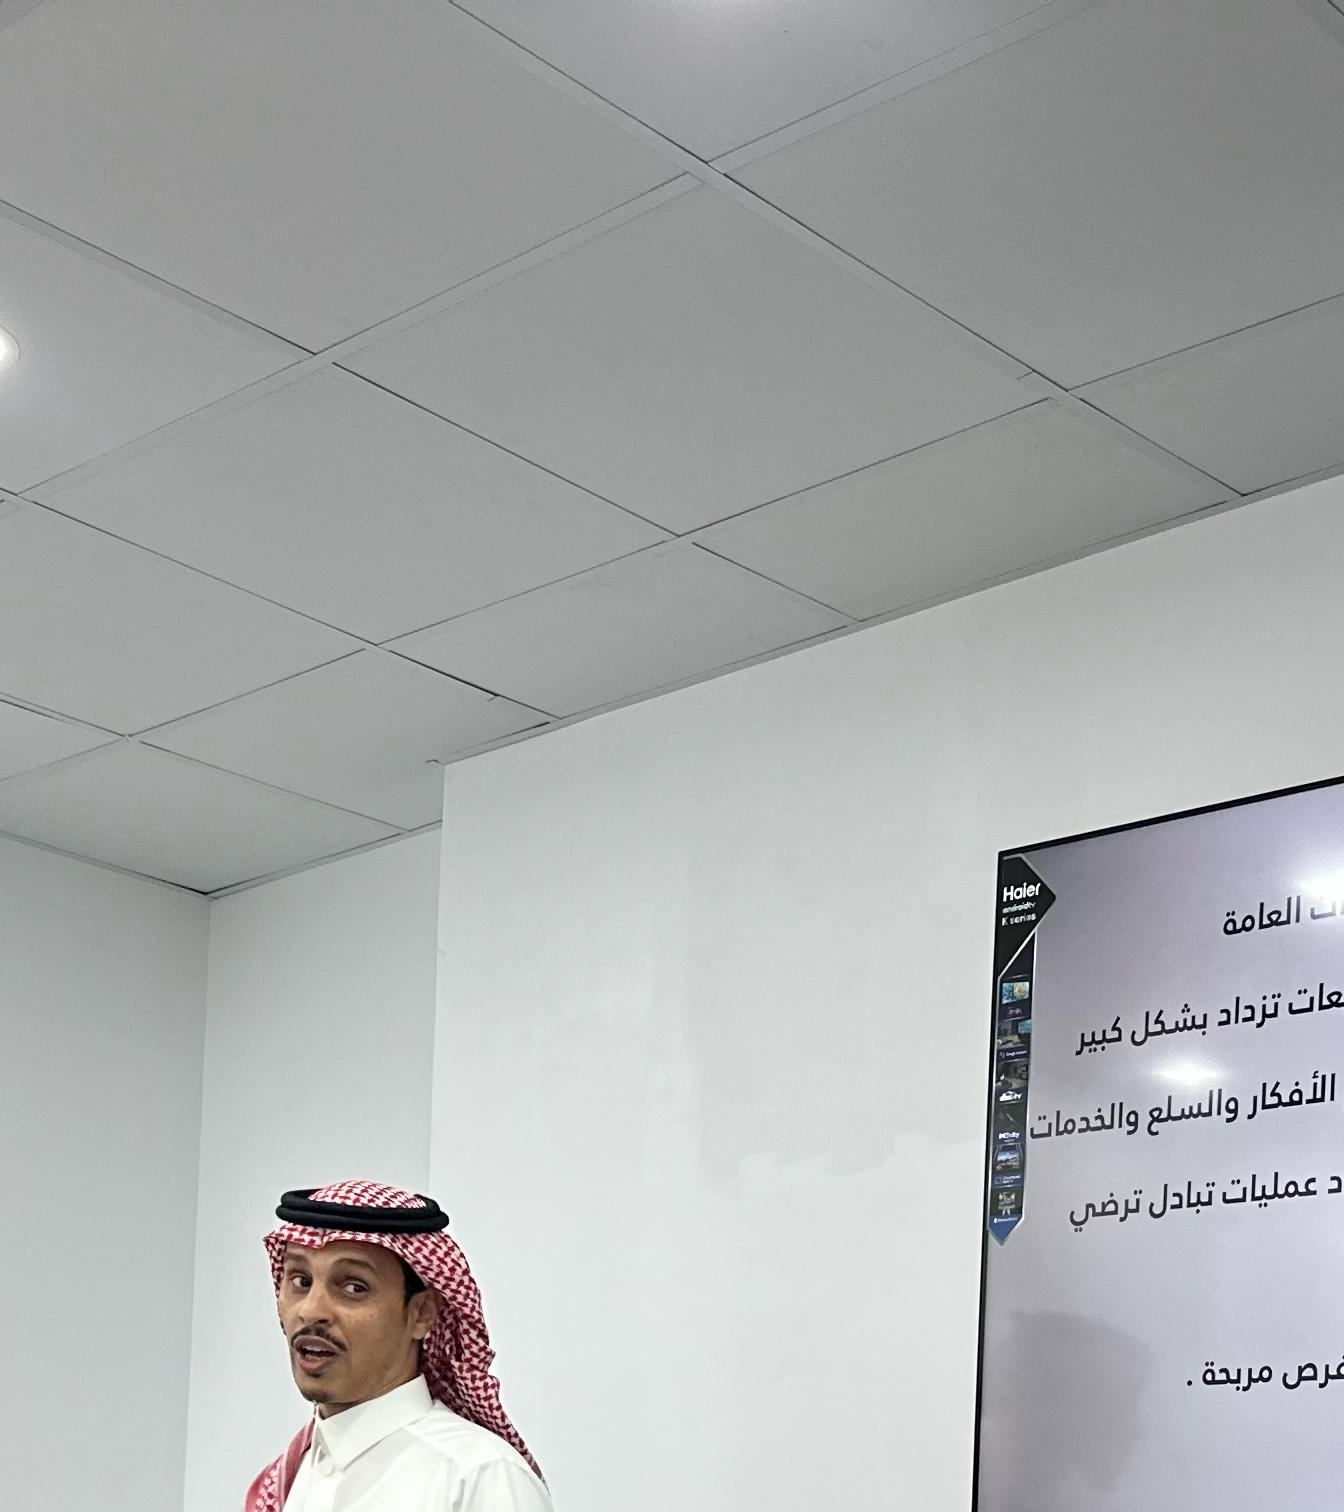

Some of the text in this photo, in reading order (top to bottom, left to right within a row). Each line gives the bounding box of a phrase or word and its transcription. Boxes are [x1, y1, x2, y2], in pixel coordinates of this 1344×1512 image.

[1002, 881, 1041, 902] Haier
[1223, 896, 1300, 935] العامة
[1131, 1003, 1207, 1046] بشكل
[1218, 993, 1281, 1028] تزداد
[1075, 1016, 1122, 1056] كبير
[1147, 1089, 1238, 1136] والسلع
[1247, 1070, 1336, 1120] الأفكار
[1030, 1102, 1138, 1139] والخدمات
[1149, 1181, 1215, 1219] تبادل
[1222, 1172, 1317, 1208] عمليات
[1070, 1189, 1142, 1232] ترضي
[1202, 1361, 1272, 1392] مربحة
